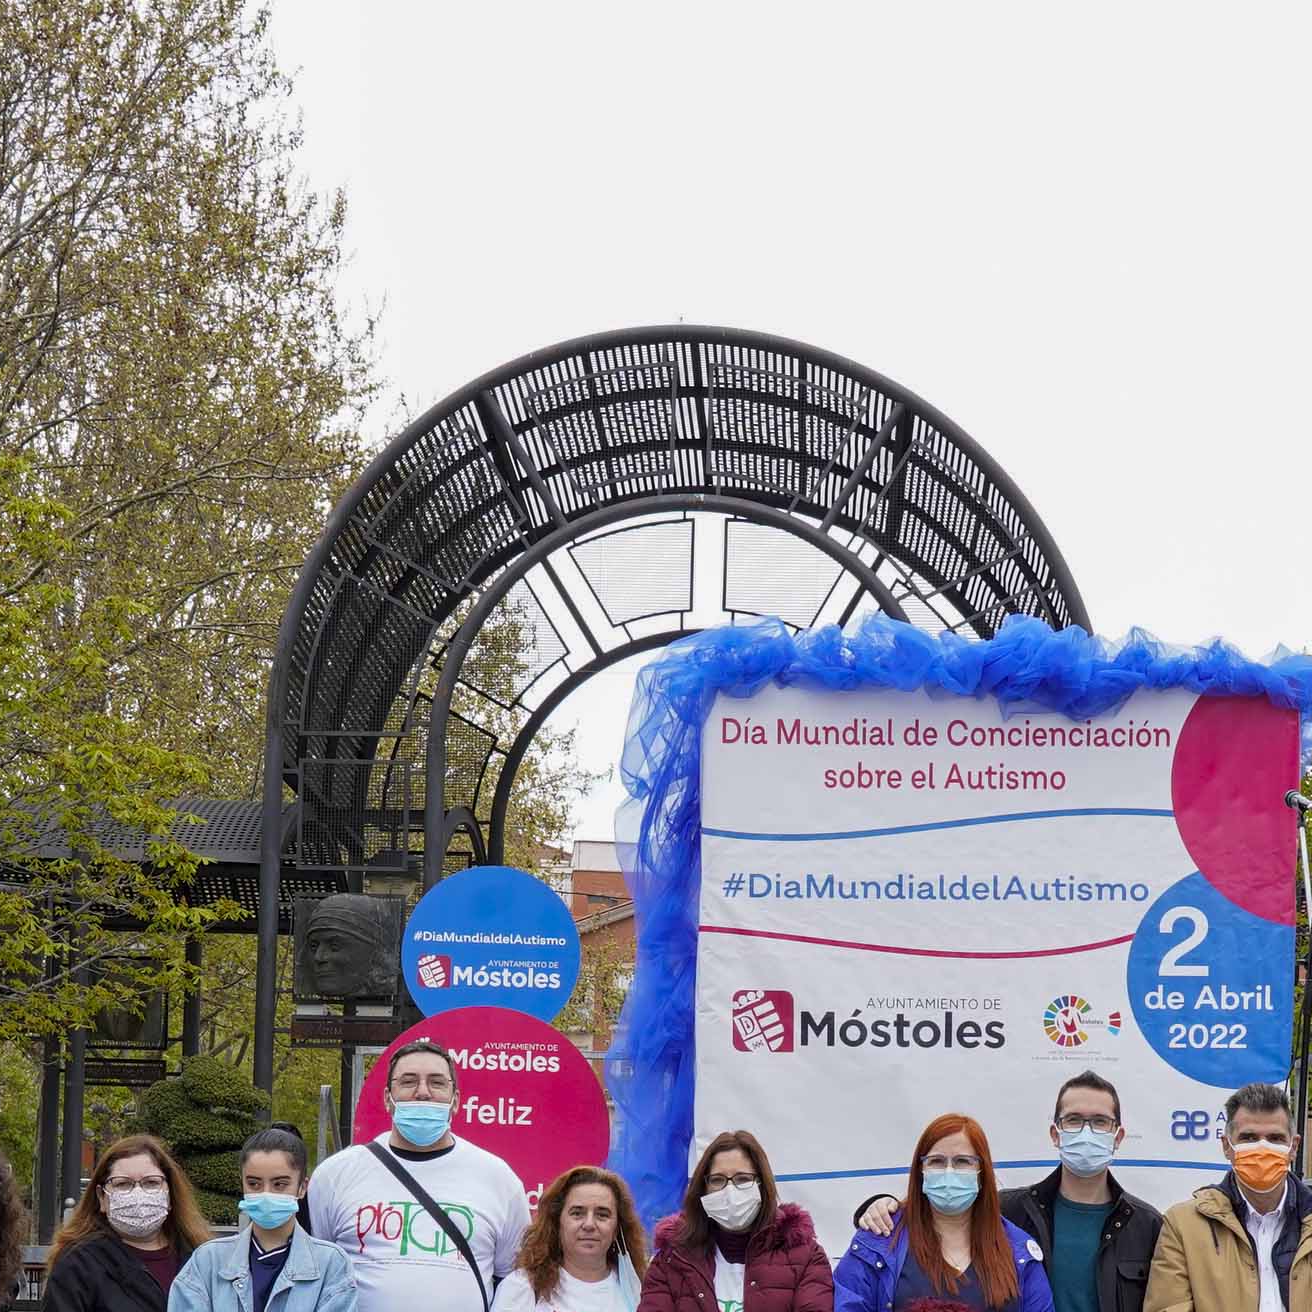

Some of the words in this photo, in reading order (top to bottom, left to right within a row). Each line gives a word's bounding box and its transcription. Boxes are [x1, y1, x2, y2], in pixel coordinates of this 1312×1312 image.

[721, 717, 768, 745] Día
[776, 718, 895, 746] Mundial
[903, 719, 938, 746] de
[946, 718, 1172, 748] Concienciación
[824, 762, 902, 789] sobre
[911, 763, 936, 790] el
[944, 763, 1066, 791] Autismo
[722, 873, 1150, 902] #DiaMundialdelAutismo
[414, 930, 567, 946] #DiaMundialdelAutismo
[1158, 906, 1210, 977] 2
[453, 965, 561, 989] Móstoles
[488, 959, 547, 969] AYUNTAMIENTO
[549, 961, 560, 969] DE
[866, 997, 979, 1010] AYUNTAMIENTO
[983, 998, 1002, 1010] DE
[1145, 984, 1185, 1010] de
[1193, 984, 1275, 1011] Abril
[800, 1008, 1006, 1049] Móstoles
[1168, 1023, 1247, 1049] 2022
[448, 1047, 561, 1073] Móstoles
[484, 1042, 547, 1052] AYUNTAMIENTO
[547, 1044, 559, 1052] DE
[462, 1095, 533, 1126] feliz
